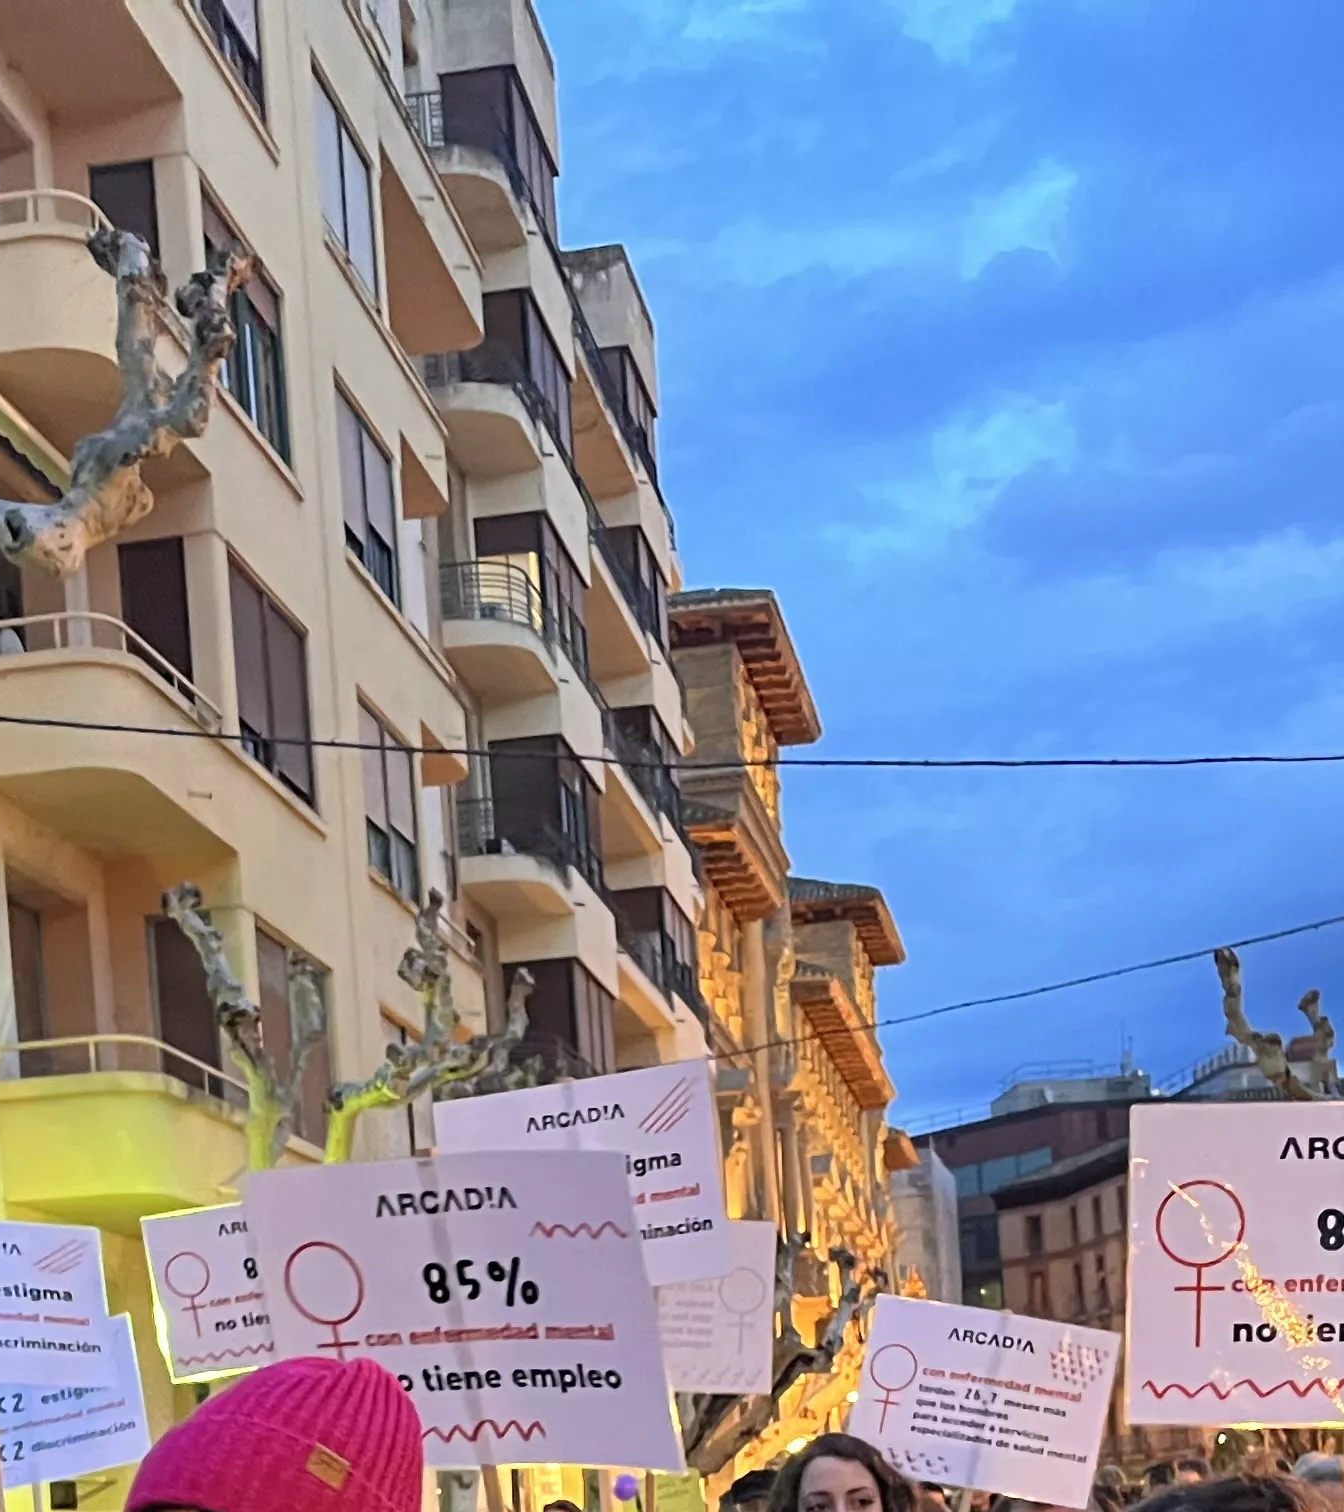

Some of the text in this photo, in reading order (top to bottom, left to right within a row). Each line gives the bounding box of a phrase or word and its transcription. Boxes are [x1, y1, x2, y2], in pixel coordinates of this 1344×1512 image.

[625, 1152, 683, 1177] igma
[640, 1217, 713, 1240] inación
[423, 1256, 540, 1307] 85%
[215, 1311, 270, 1332] no tien
[1233, 1322, 1277, 1342] no
[364, 1333, 403, 1347] con
[397, 1363, 622, 1393] o tiene empleo
[950, 1372, 1031, 1393] enfermedad
[12, 1393, 25, 1412] 2
[41, 1386, 102, 1405] estig
[13, 1440, 25, 1461] 2
